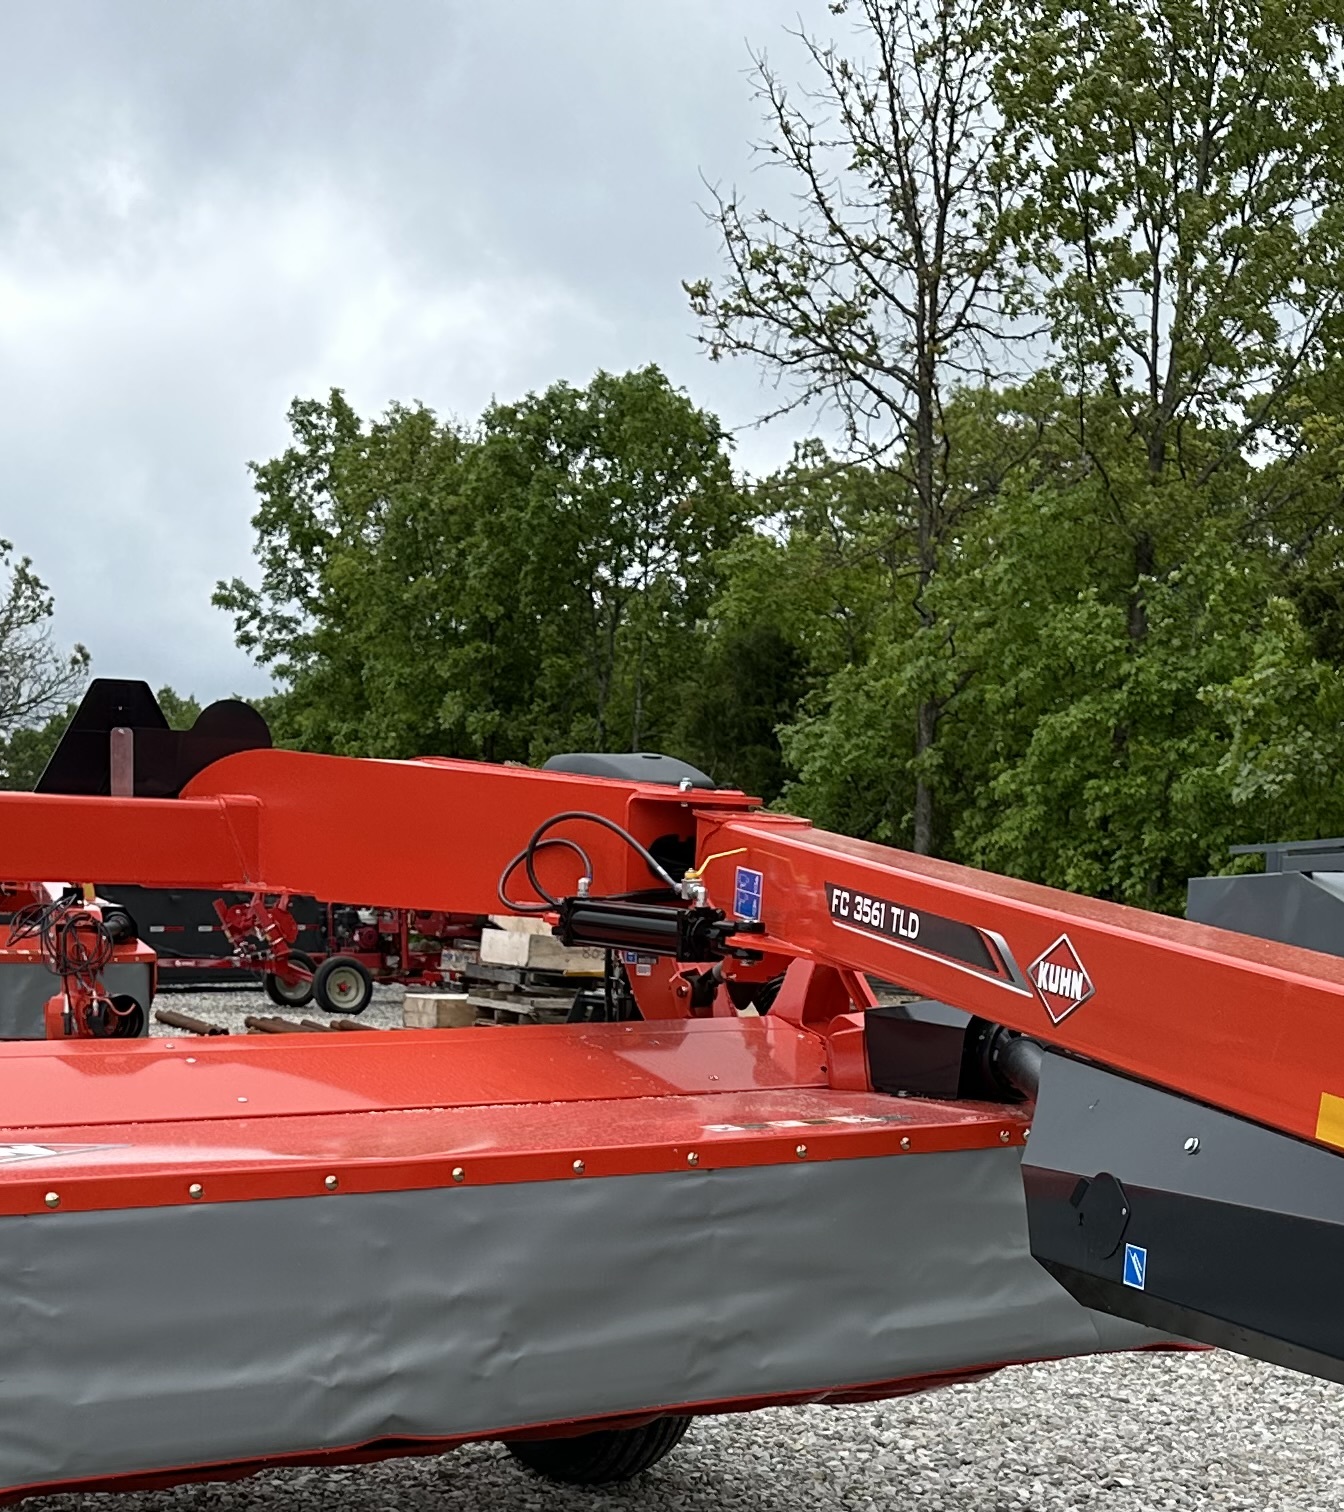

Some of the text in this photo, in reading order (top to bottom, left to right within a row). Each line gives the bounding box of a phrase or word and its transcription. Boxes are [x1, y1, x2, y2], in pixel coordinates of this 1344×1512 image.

[831, 888, 920, 940] FC 3561 TLD
[1037, 961, 1084, 1001] KUHN
